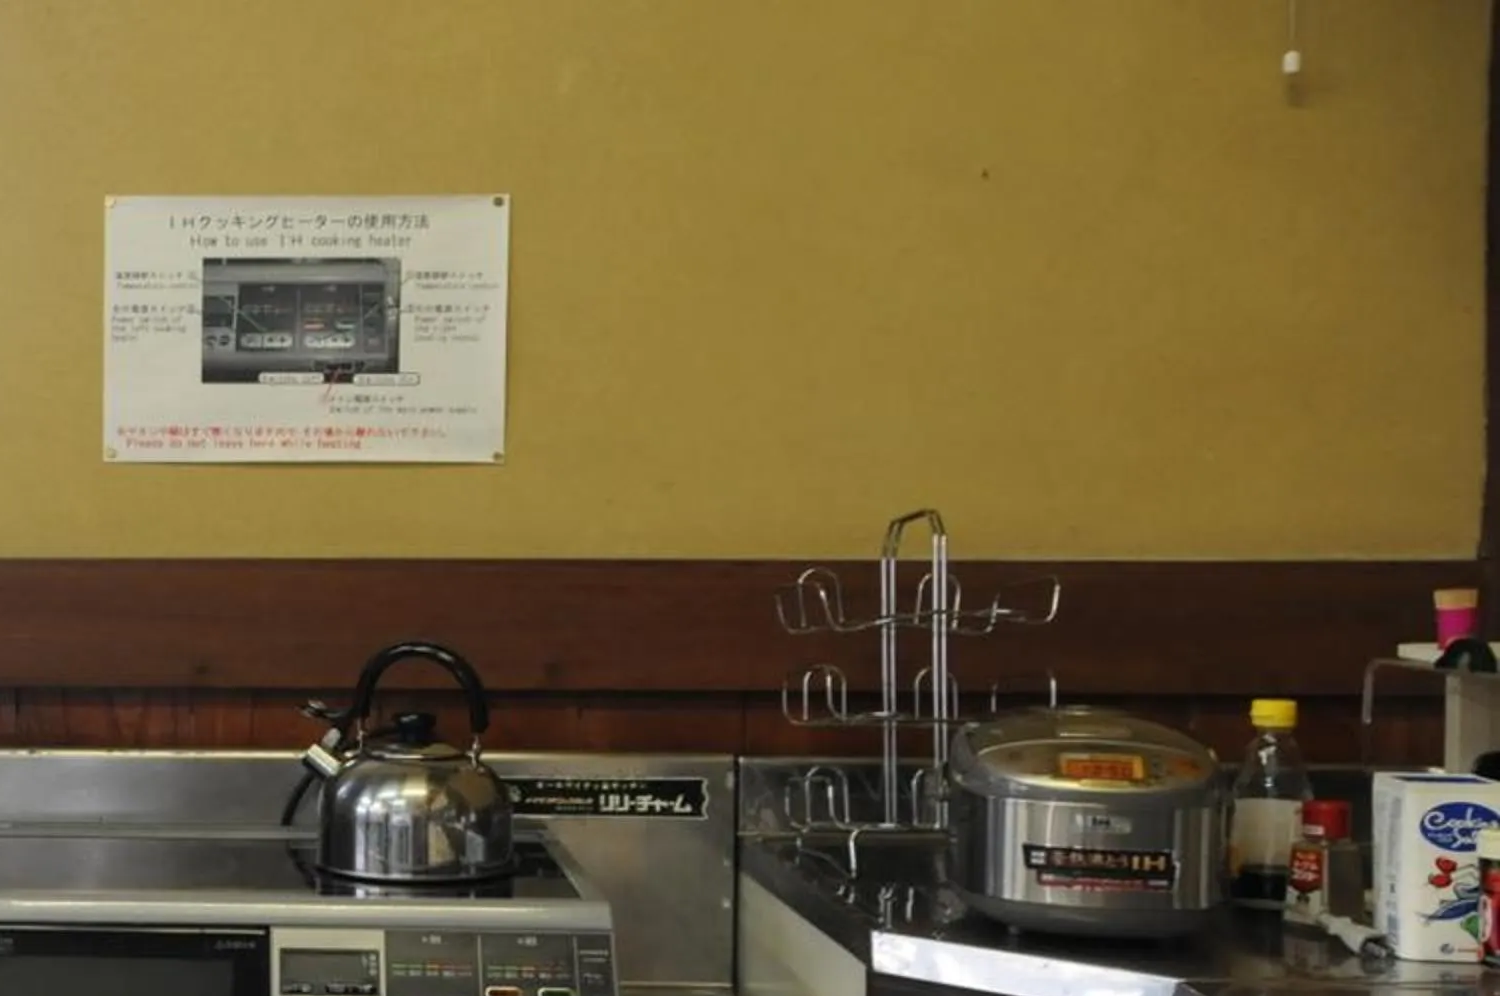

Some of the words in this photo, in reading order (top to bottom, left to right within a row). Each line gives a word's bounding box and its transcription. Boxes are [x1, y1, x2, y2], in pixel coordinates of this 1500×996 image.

[189, 235, 218, 249] How
[225, 235, 240, 249] to
[245, 237, 268, 249] use
[311, 235, 363, 250] cooking
[368, 235, 412, 249] heater
